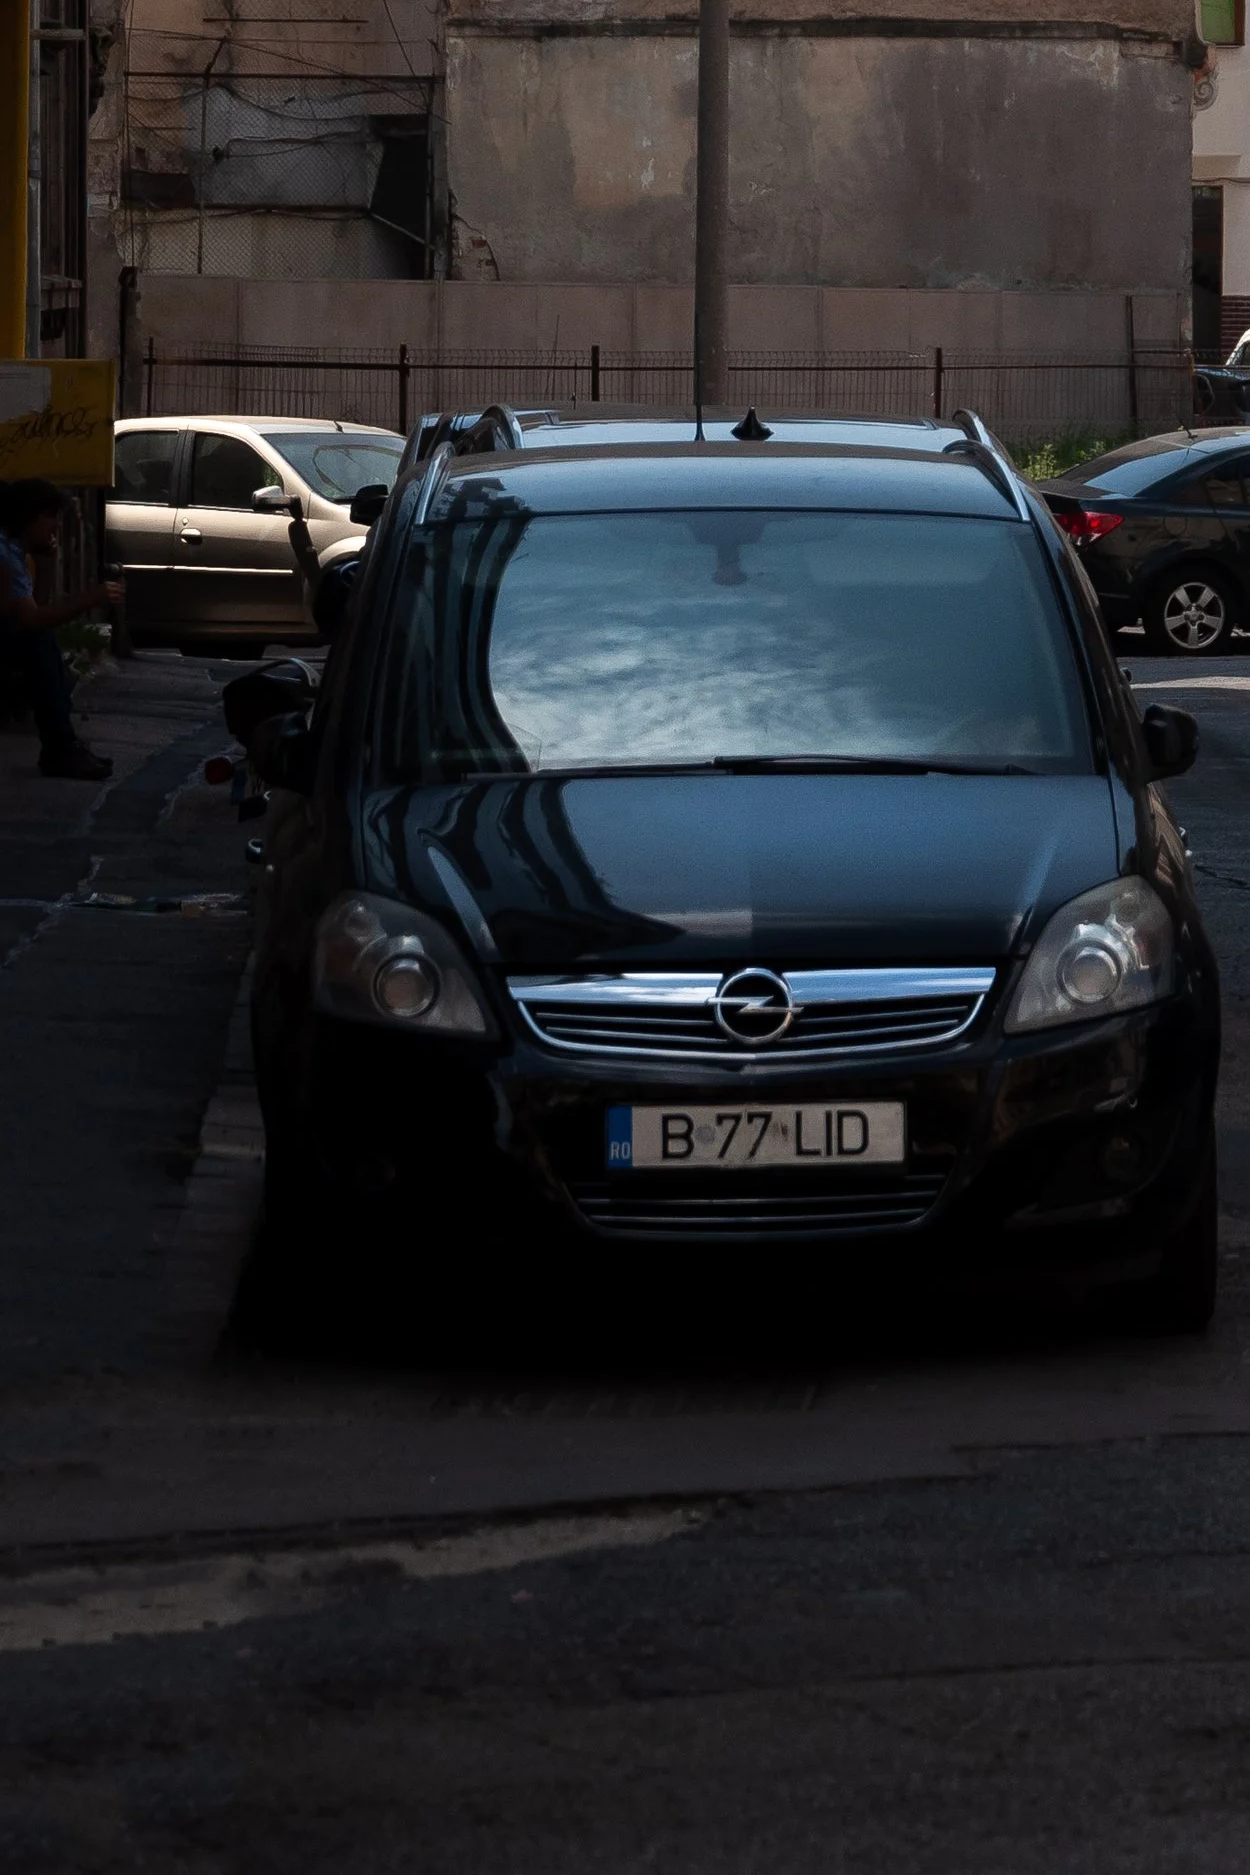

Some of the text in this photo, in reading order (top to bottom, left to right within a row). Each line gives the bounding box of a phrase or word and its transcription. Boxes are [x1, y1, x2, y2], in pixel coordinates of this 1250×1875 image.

[609, 1141, 631, 1160] RO
[661, 1110, 869, 1160] B 77 LID
